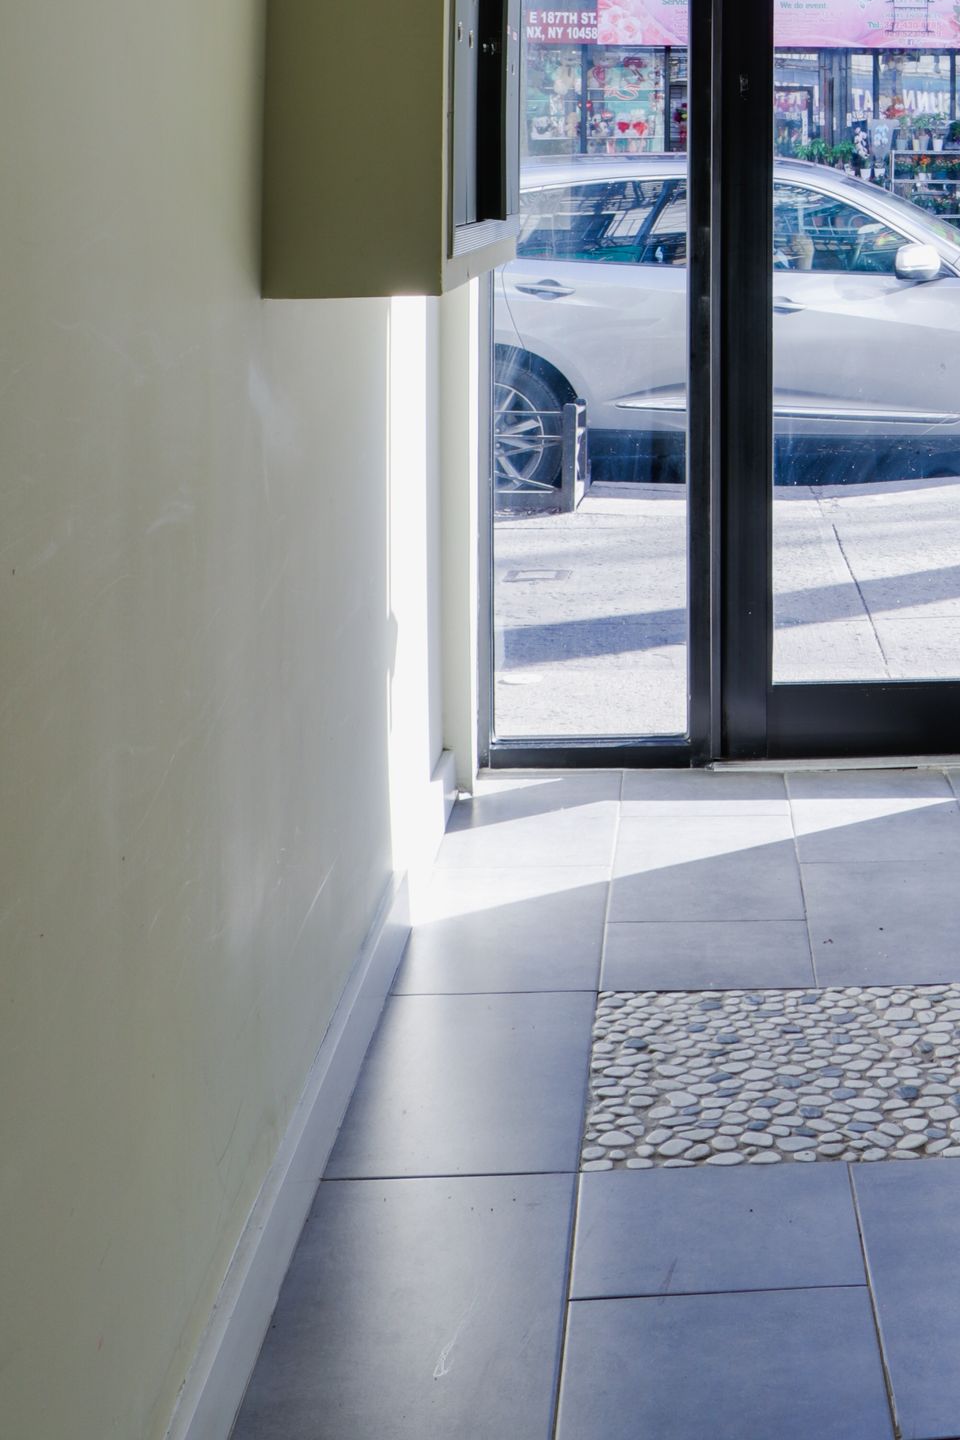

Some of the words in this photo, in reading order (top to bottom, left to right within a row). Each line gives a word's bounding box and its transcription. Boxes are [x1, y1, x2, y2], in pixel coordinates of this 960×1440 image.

[780, 1, 792, 9] We
[794, 1, 803, 9] do
[529, 12, 538, 24] E
[541, 12, 578, 24] 187TH
[581, 13, 598, 25] ST.
[526, 27, 545, 41] NX,
[547, 27, 564, 39] NY
[566, 27, 598, 40] 10458
